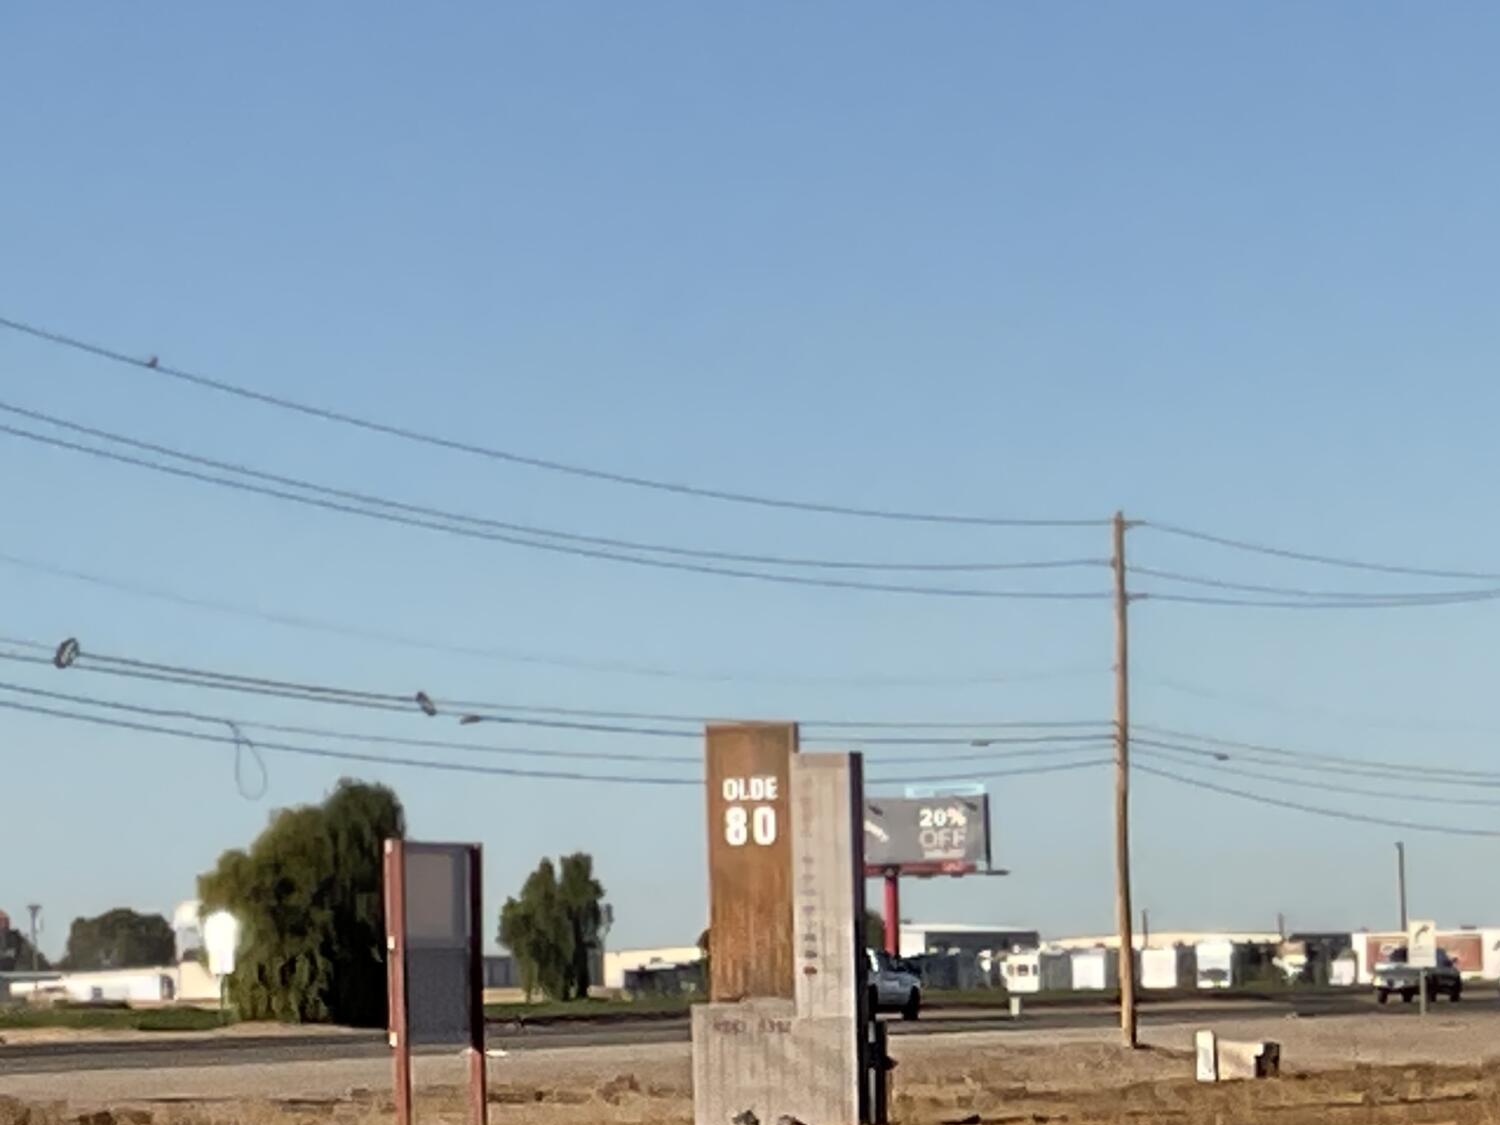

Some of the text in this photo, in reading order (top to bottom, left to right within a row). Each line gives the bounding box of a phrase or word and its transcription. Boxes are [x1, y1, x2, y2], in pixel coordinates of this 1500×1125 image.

[723, 777, 779, 801] OLDE
[724, 806, 777, 846] 80
[919, 807, 967, 828] 20%
[918, 828, 967, 850] OFF
